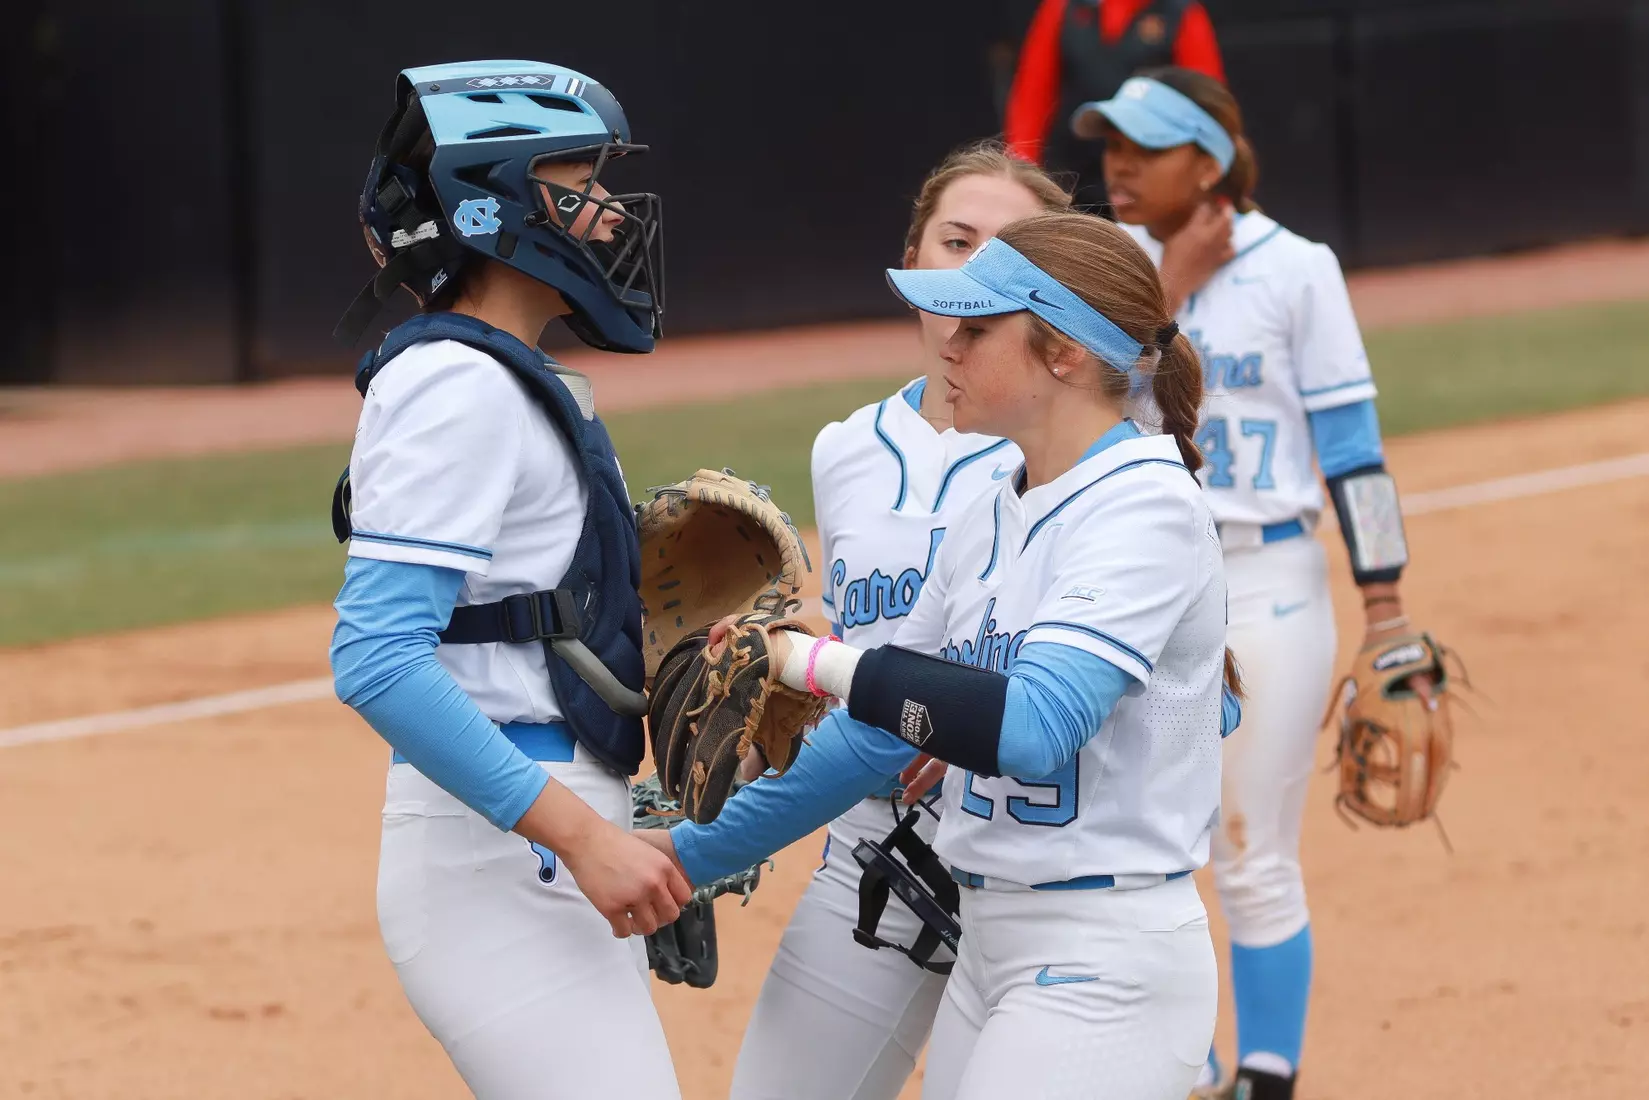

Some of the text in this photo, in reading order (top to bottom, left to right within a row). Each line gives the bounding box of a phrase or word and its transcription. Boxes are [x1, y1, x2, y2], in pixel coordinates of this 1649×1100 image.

[932, 299, 995, 310] SOFTBALL
[1195, 417, 1277, 489] 47
[830, 526, 946, 629] Carol
[906, 703, 918, 741] ZONE
[914, 706, 925, 745] SPORTS
